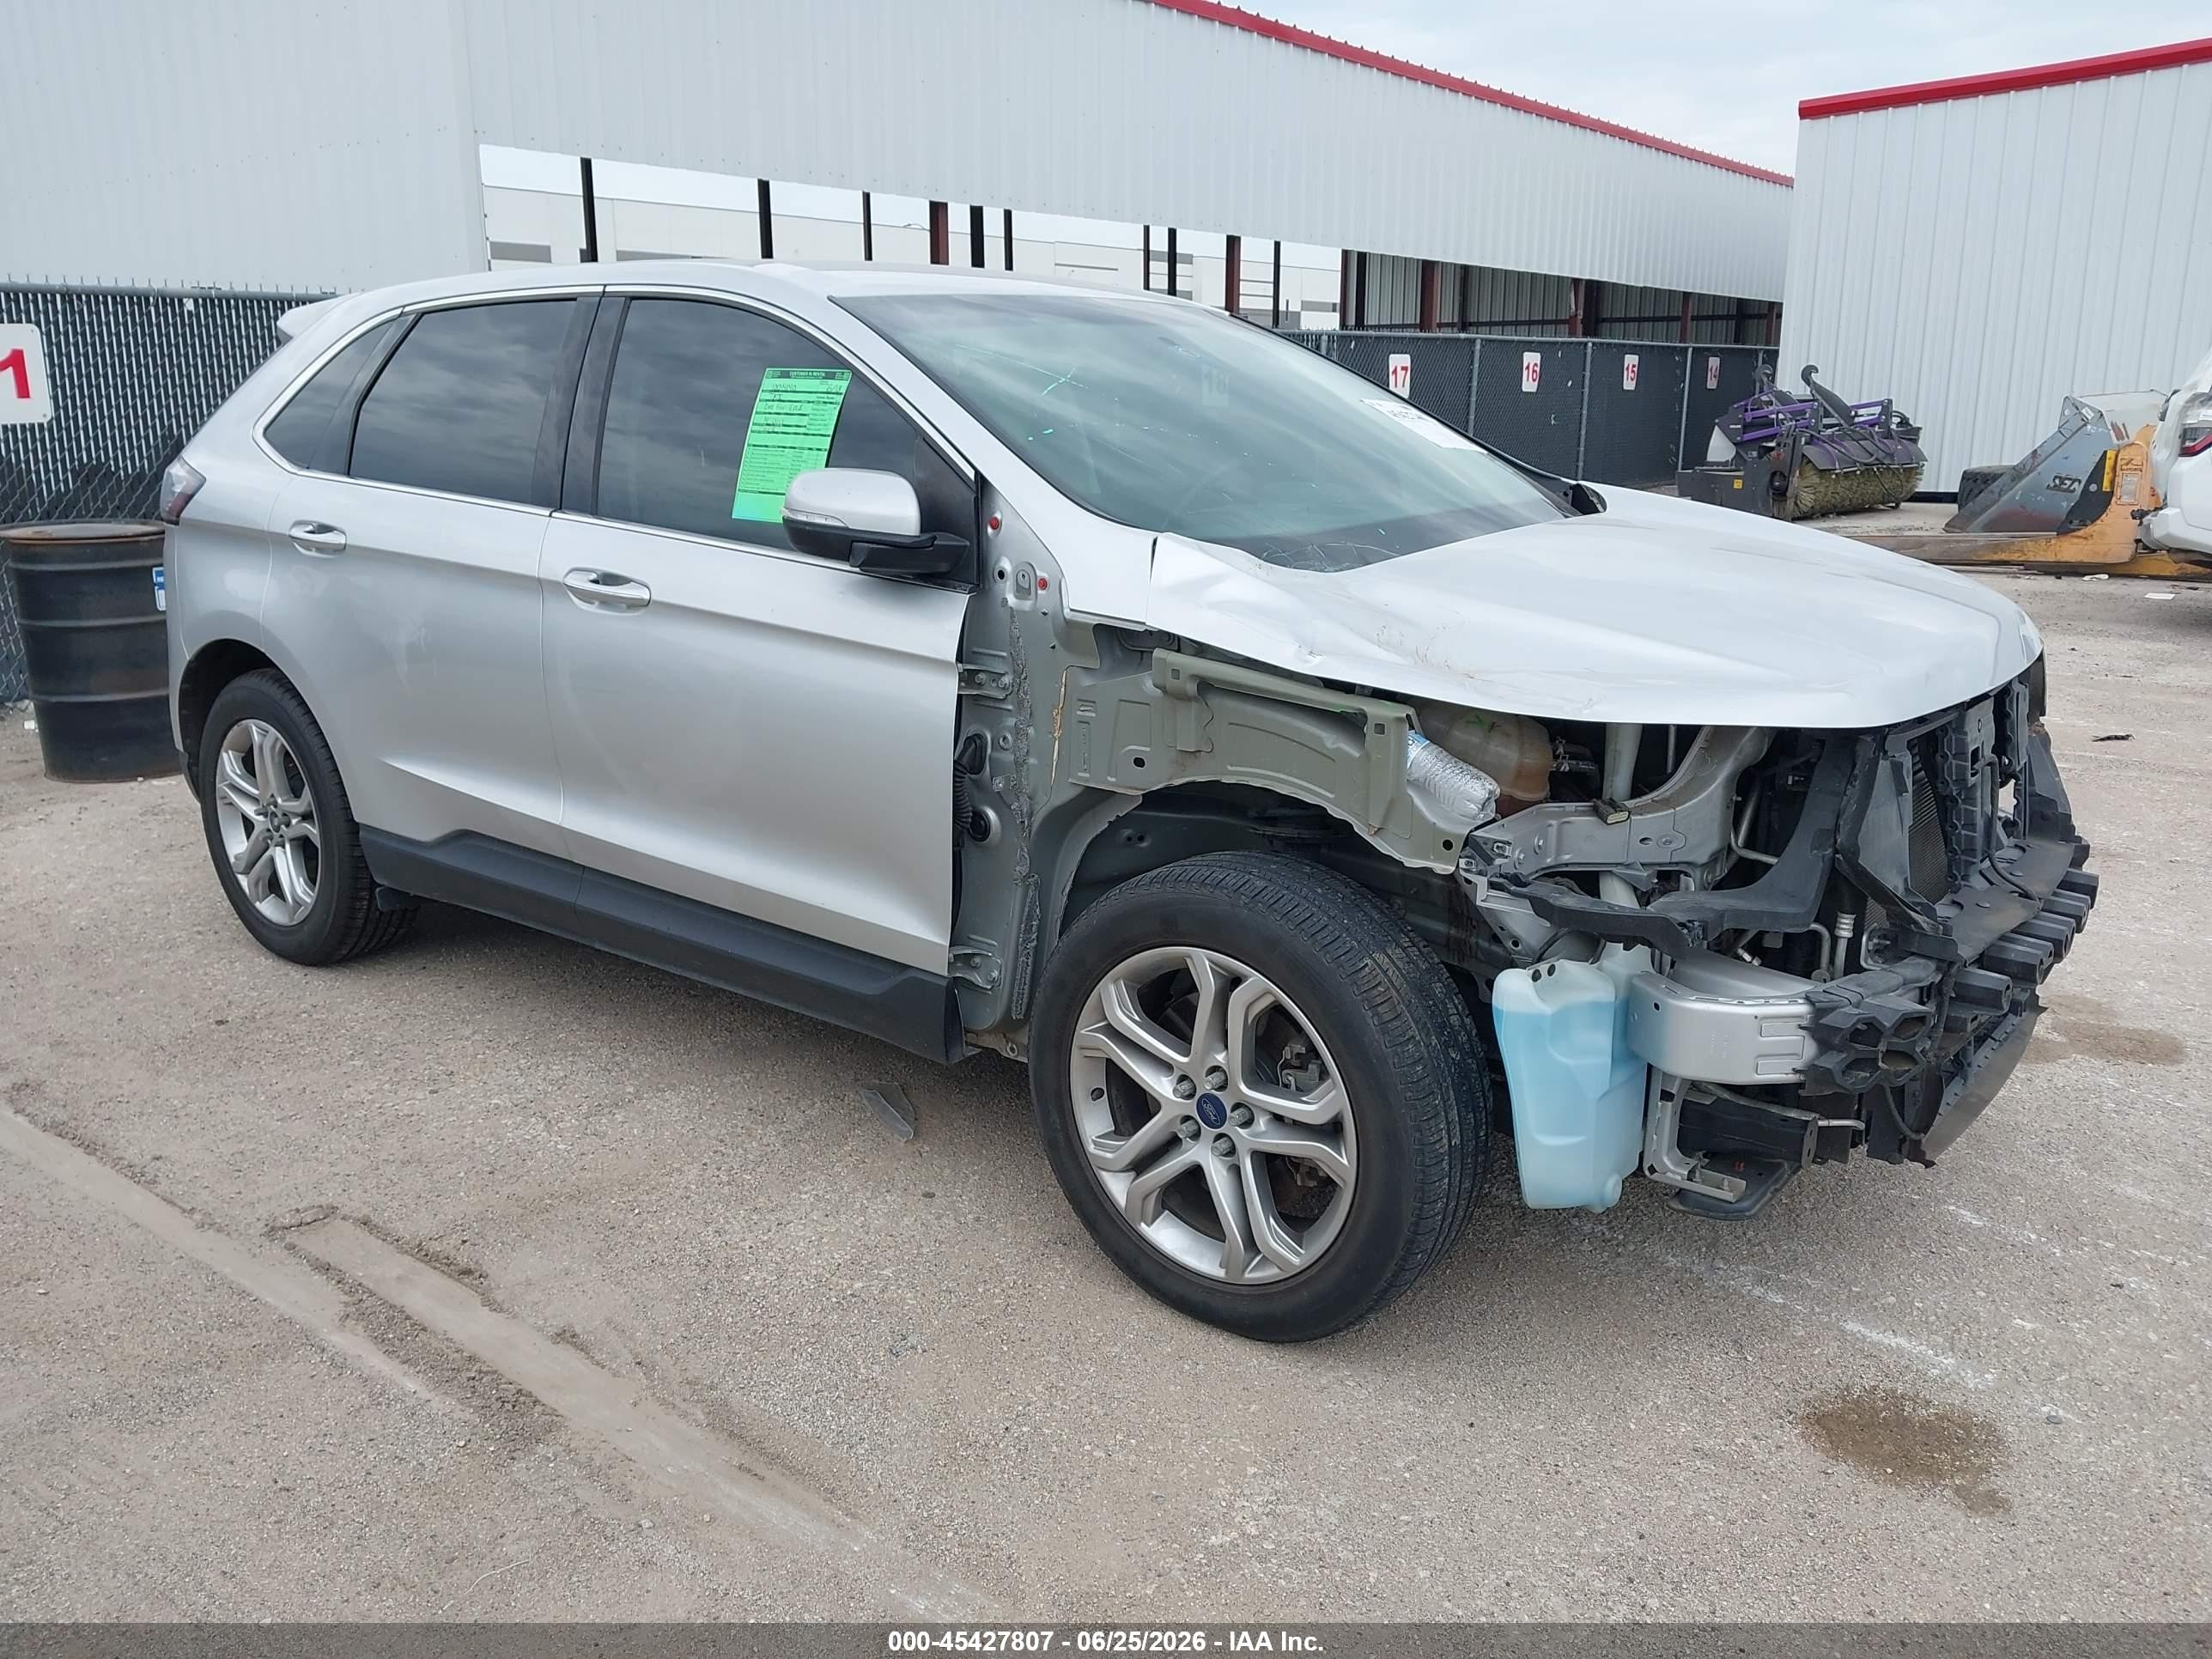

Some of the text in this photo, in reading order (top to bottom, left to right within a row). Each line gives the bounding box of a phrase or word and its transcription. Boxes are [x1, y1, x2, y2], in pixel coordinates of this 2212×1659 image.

[0, 349, 31, 399] 1
[1391, 366, 1409, 388] 17
[1524, 362, 1539, 383] 16
[1626, 363, 1637, 381] 15
[1709, 365, 1718, 380] 14
